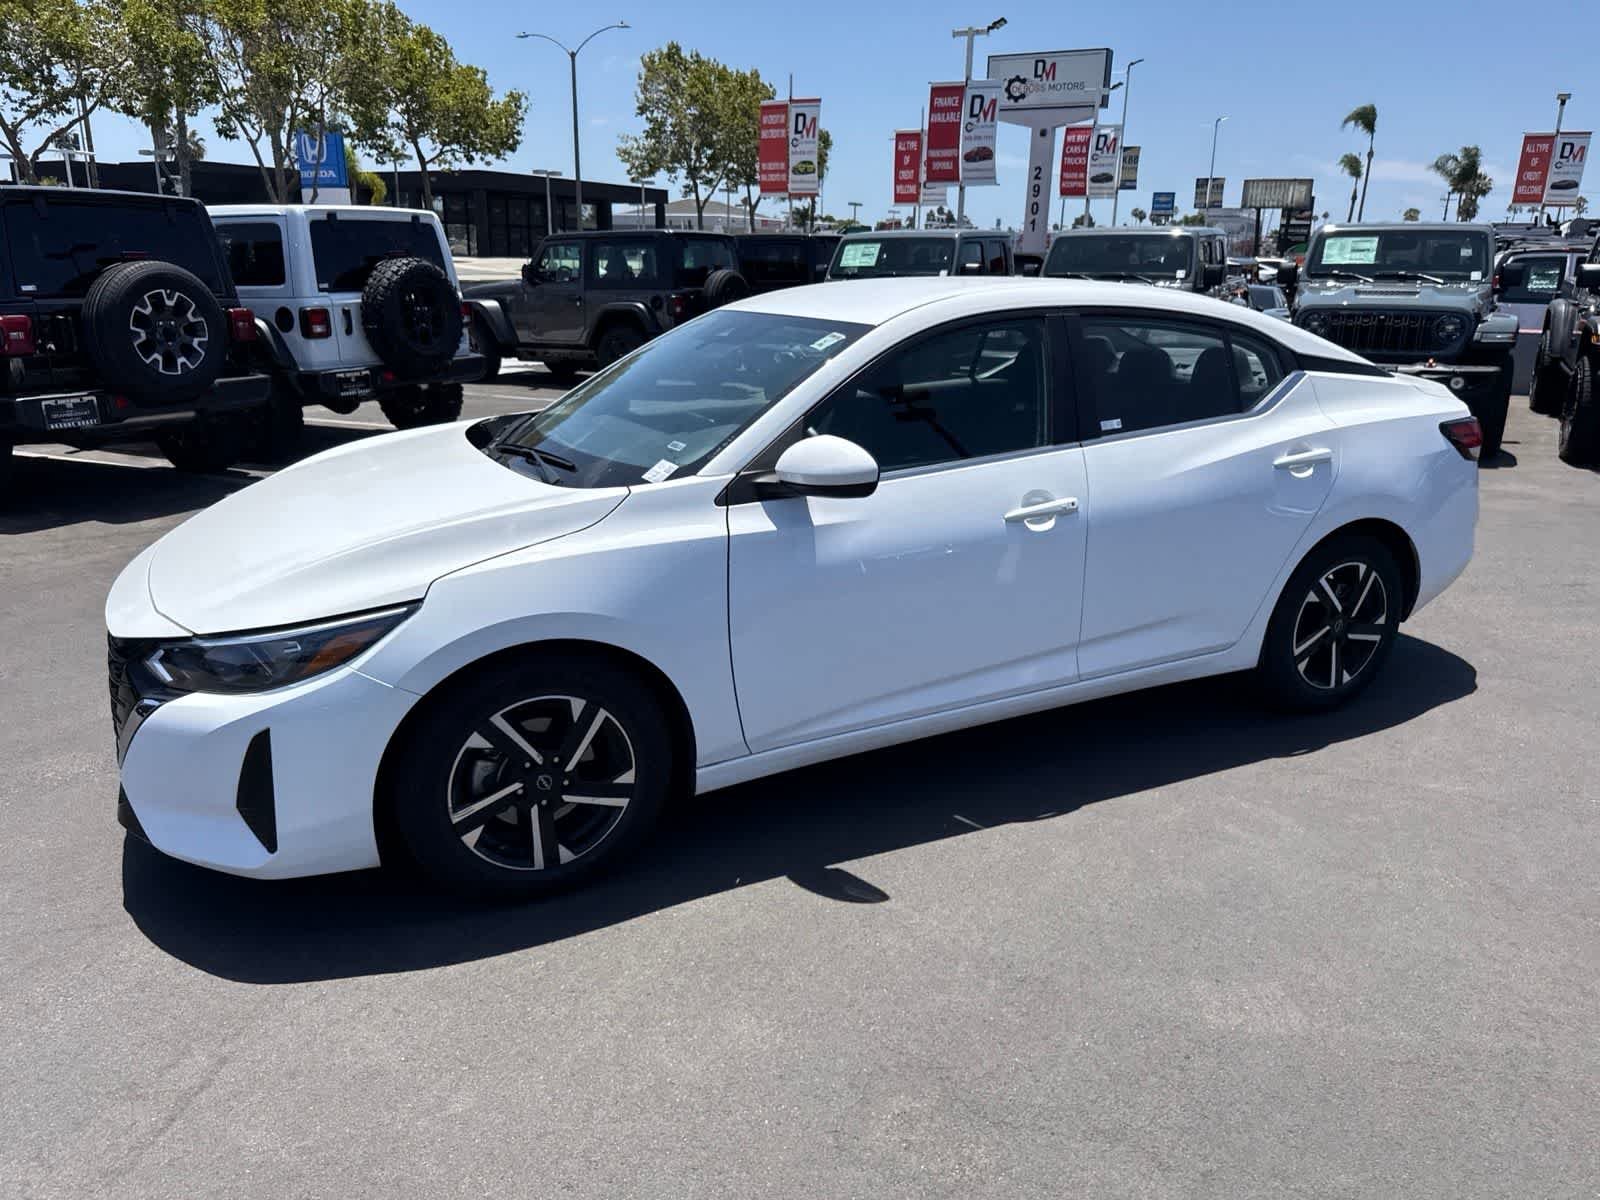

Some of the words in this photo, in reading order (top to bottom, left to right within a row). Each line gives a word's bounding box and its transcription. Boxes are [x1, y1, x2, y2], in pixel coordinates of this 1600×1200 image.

[1048, 81, 1085, 92] MOTORS
[934, 96, 960, 107] FINANCE
[930, 111, 961, 123] AVAILABLE
[1063, 156, 1087, 166] TRUCKS
[1030, 166, 1042, 232] 2901
